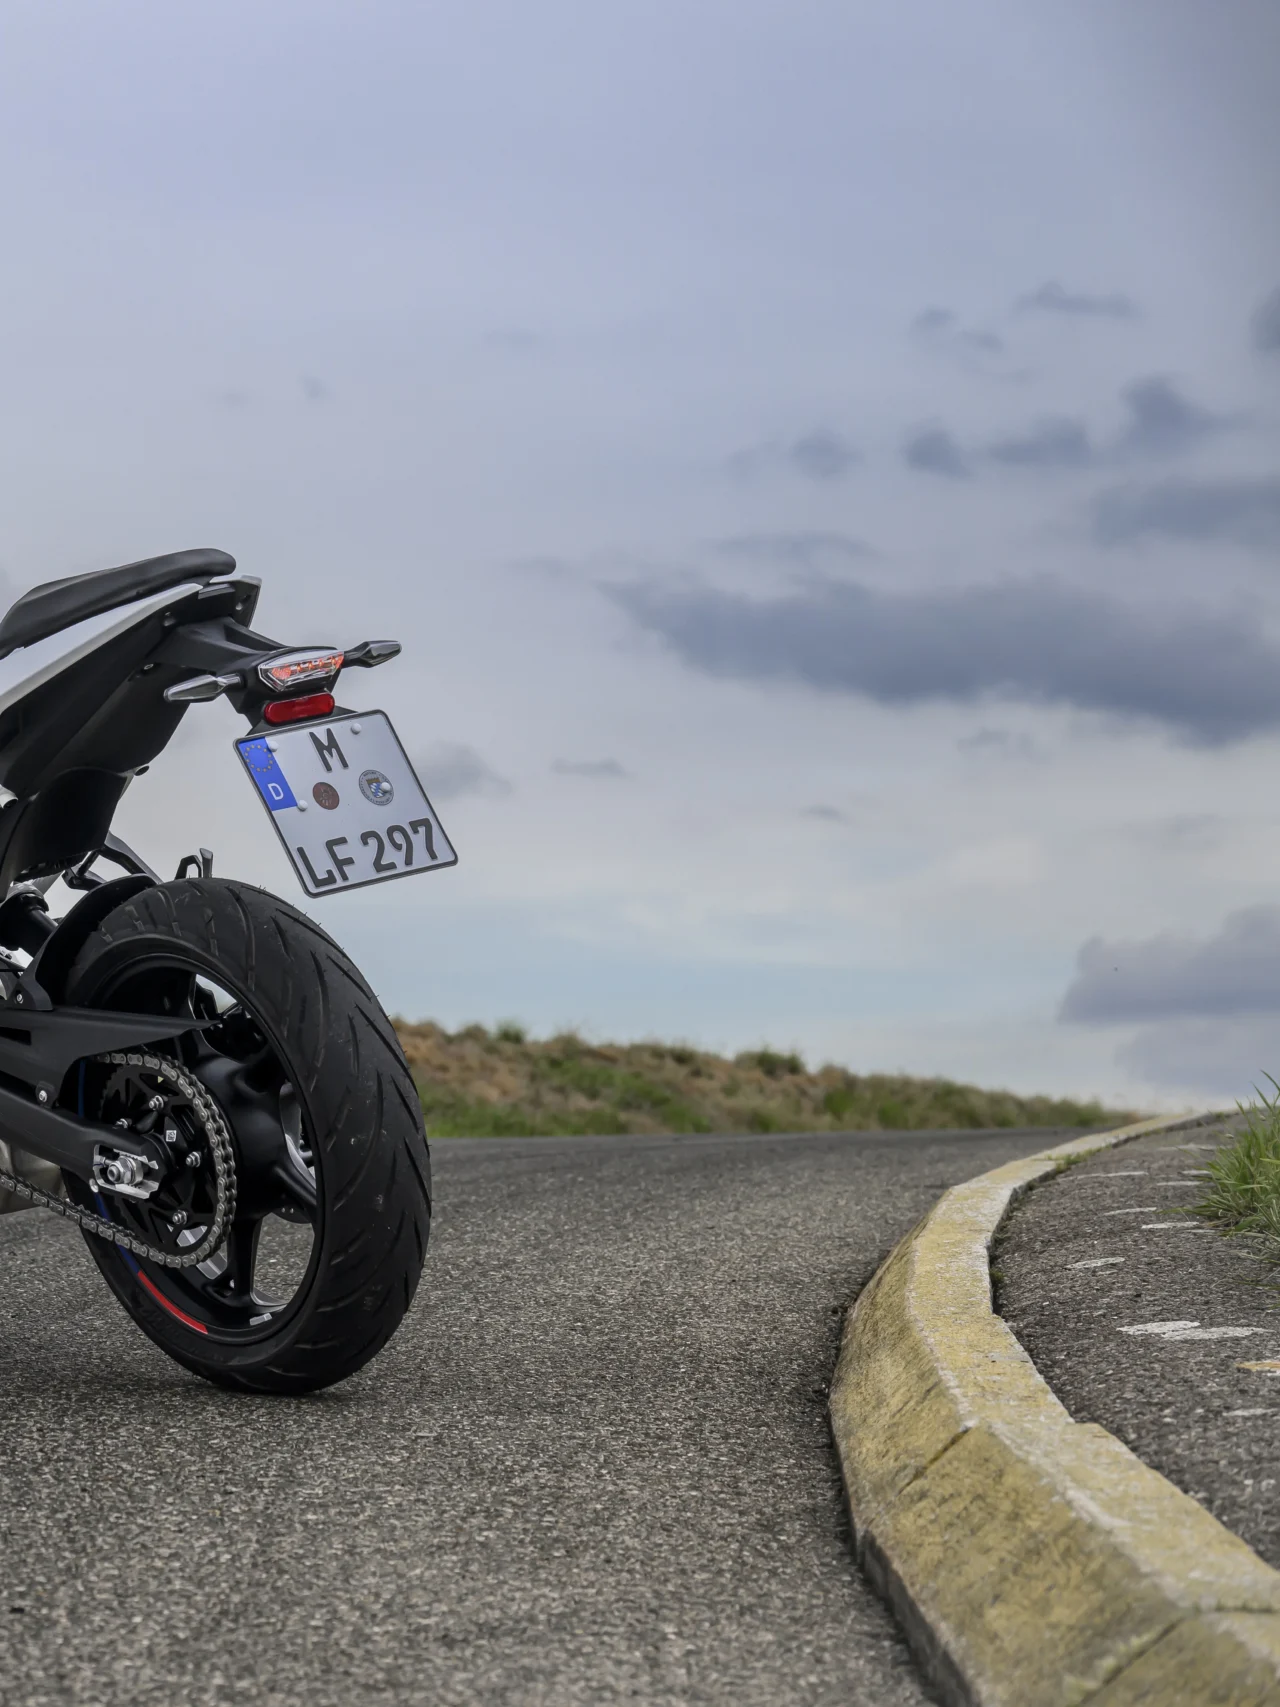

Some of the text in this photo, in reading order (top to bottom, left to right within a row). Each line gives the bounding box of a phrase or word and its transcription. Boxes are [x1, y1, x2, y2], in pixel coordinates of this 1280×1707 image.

[309, 727, 349, 772] M
[268, 782, 284, 800] D
[296, 817, 438, 888] LF 297
